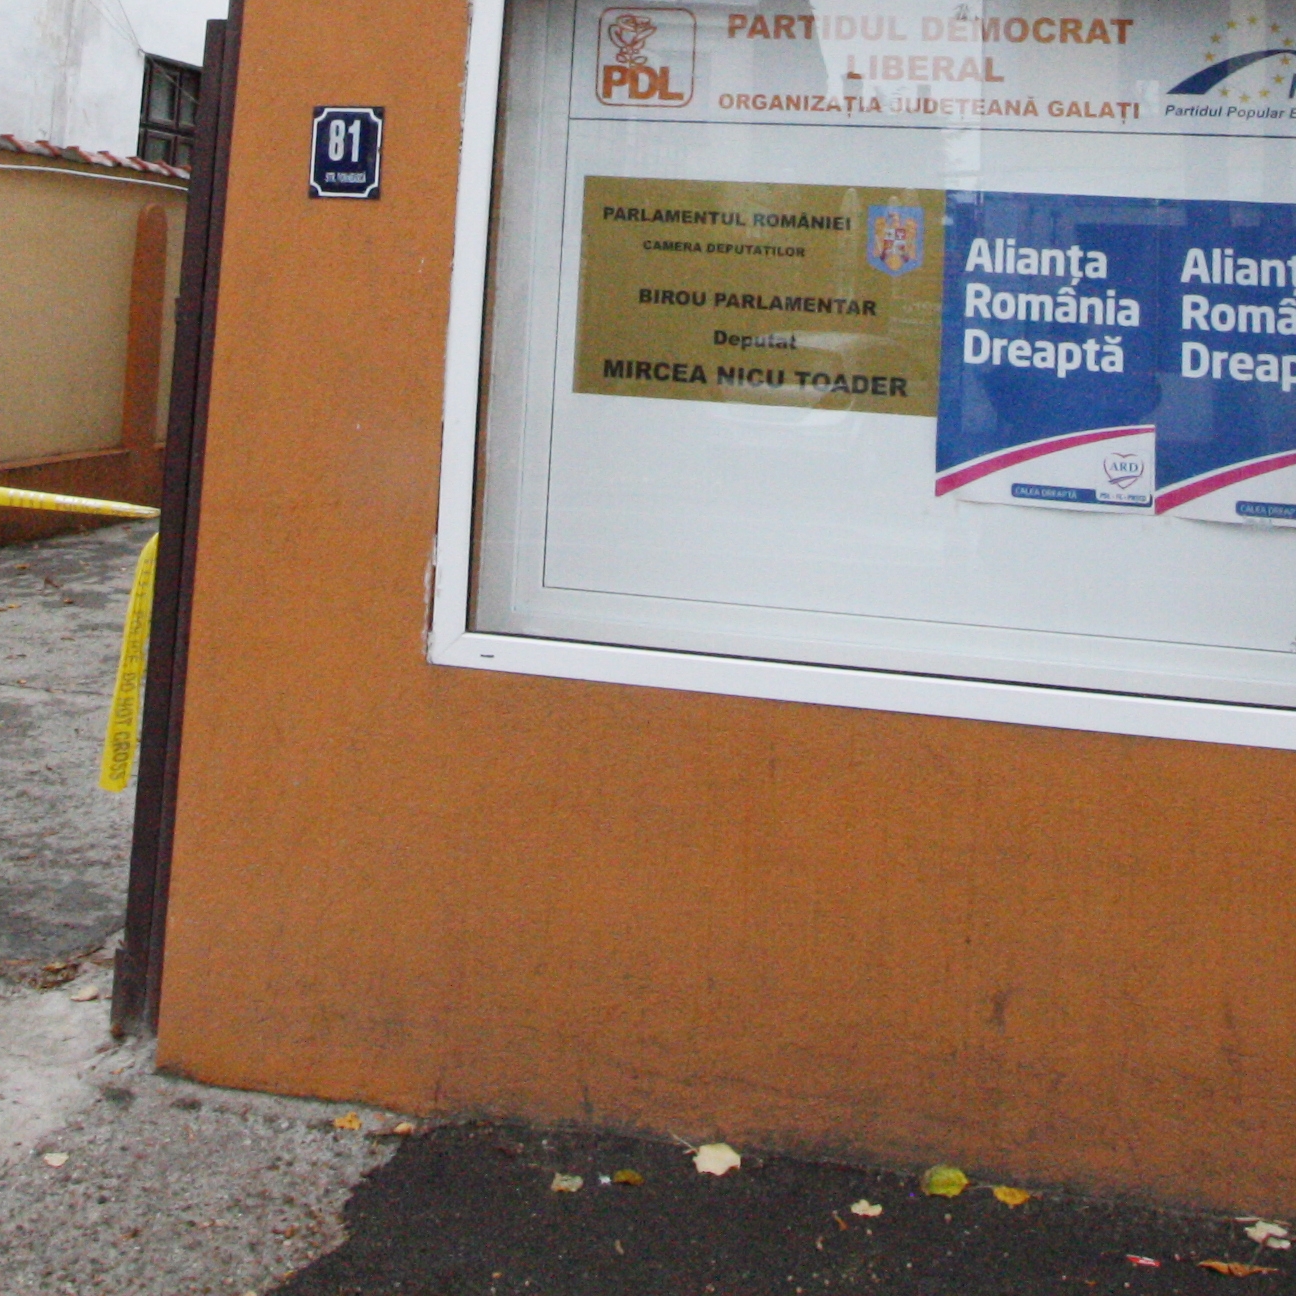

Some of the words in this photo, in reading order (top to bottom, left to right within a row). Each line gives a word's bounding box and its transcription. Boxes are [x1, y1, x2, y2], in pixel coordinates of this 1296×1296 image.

[727, 13, 908, 42] PARTIDUL
[920, 15, 1135, 45] DEMOCRAT
[602, 64, 685, 101] PDL
[846, 54, 1005, 84] LIBERAL
[1164, 104, 1223, 118] Partidul
[1225, 106, 1285, 121] Popular
[328, 119, 361, 162] 81
[603, 206, 746, 228] PARLAMENTUL
[753, 208, 852, 232] ROMÂNIEI
[642, 239, 702, 254] CAMERA
[964, 237, 1109, 287] Alianța
[638, 287, 707, 307] BIROU
[713, 291, 878, 317] PARLAMENTAR
[963, 281, 1141, 328] România
[713, 329, 798, 352] Deputat
[962, 328, 1125, 379] Dreaptă
[603, 359, 708, 386] MIRCEA
[716, 365, 785, 390] NICU
[793, 369, 910, 399] TOADER
[1109, 461, 1139, 473] ARD
[114, 696, 135, 728] NOT
[109, 730, 132, 782] CROSS
